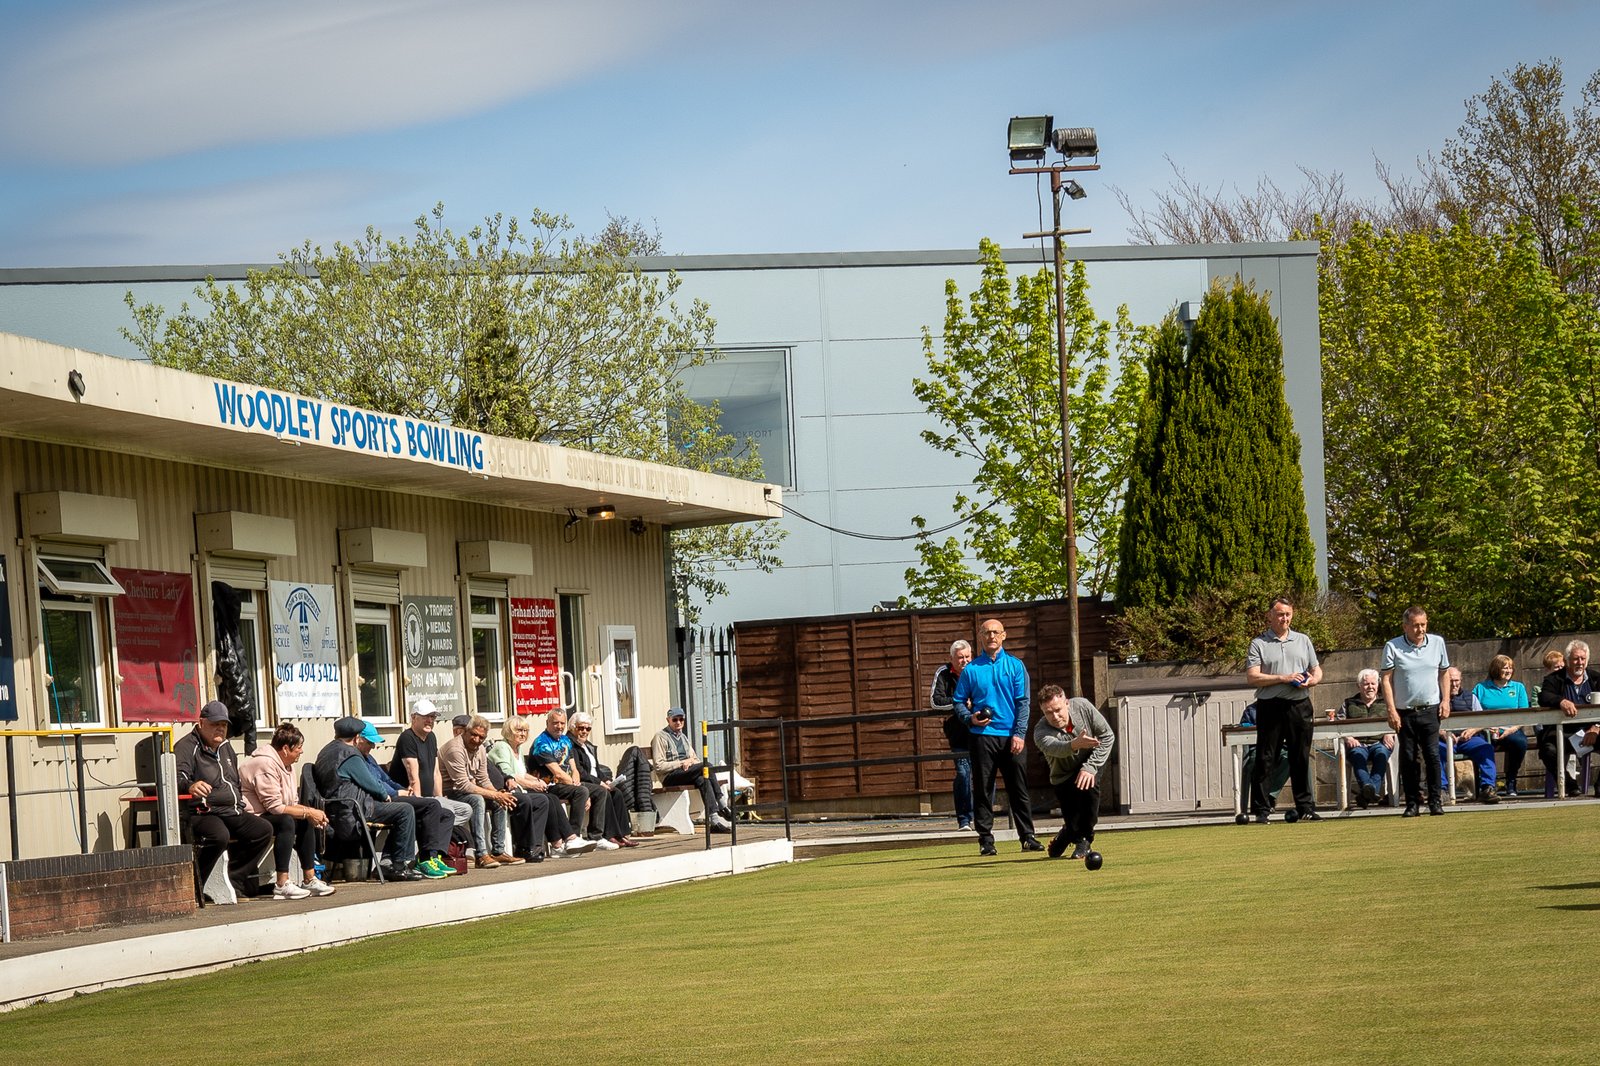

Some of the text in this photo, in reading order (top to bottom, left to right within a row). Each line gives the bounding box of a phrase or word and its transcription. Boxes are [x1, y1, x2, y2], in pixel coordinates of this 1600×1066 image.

[214, 382, 550, 480] WOODLEY SPORTS BOWLING SECTION
[124, 580, 181, 600] Cheshire Lady
[428, 604, 453, 617] TROPHIES
[511, 604, 555, 618] Graham's Barbers
[274, 624, 290, 634] SHING
[429, 621, 451, 634] MEDALS
[431, 638, 453, 651] AWARDS
[432, 655, 457, 666] ENGRAVING
[276, 662, 294, 682] 0161
[298, 662, 316, 682] 494
[411, 672, 424, 688] 0161
[425, 672, 438, 687] 494
